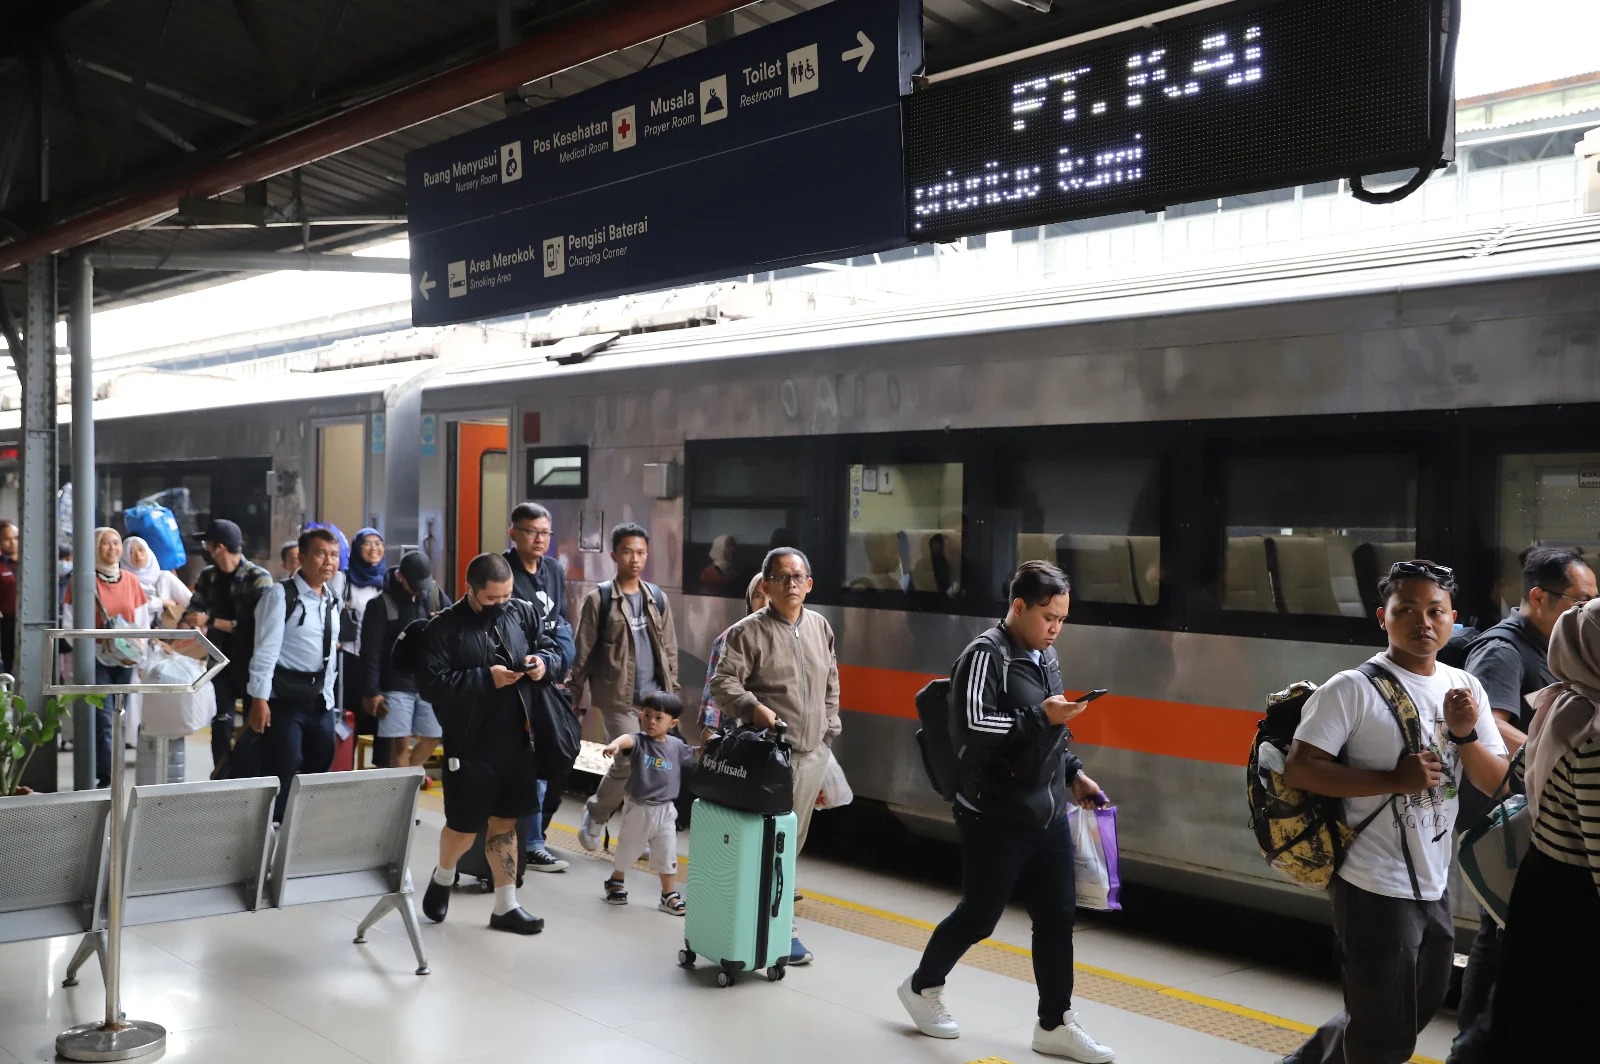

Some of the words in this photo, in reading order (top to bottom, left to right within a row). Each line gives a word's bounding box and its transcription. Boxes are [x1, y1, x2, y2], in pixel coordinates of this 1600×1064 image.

[743, 59, 782, 86] Toilet
[650, 89, 695, 117] Musala
[740, 85, 782, 108] Restroom
[533, 139, 551, 154] Pos
[553, 119, 608, 149] Kesehatan
[644, 121, 670, 137] Prayer
[672, 112, 695, 129] Room
[559, 146, 587, 163] Medical
[588, 140, 609, 155] Room
[424, 169, 450, 188] Ruang
[453, 150, 497, 177] Menyusui
[455, 178, 479, 193] Nursery
[480, 173, 498, 186] Room
[569, 226, 606, 251] Pengisi
[609, 215, 648, 241] Baterai
[469, 259, 491, 274] Area
[493, 245, 535, 270] Merokok
[568, 251, 601, 268] Charging
[602, 246, 628, 261] Corner
[469, 274, 496, 290] Smoking
[497, 272, 512, 284] Area
[644, 754, 673, 771] TREND
[715, 759, 748, 779] Husada
